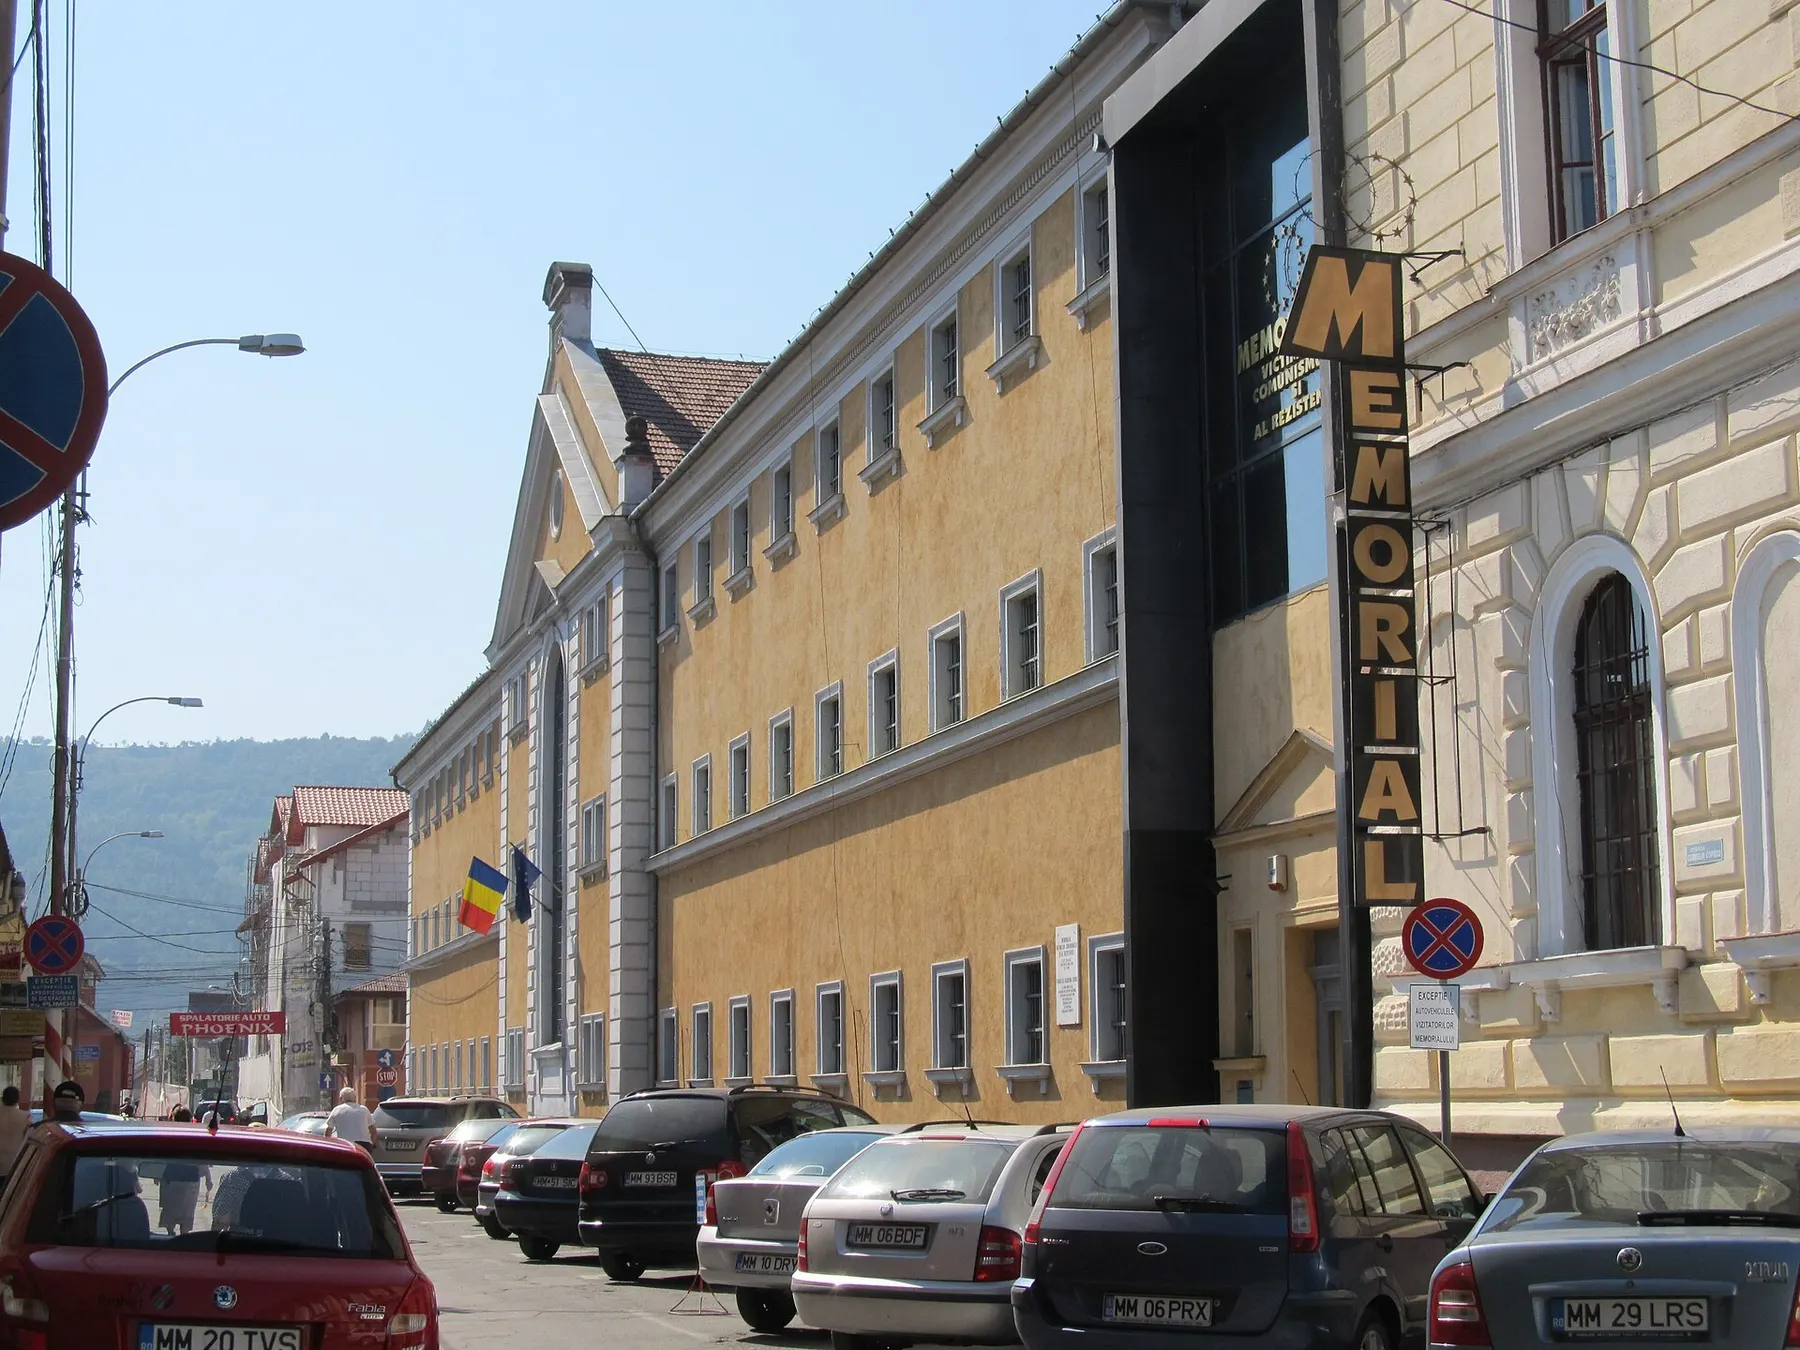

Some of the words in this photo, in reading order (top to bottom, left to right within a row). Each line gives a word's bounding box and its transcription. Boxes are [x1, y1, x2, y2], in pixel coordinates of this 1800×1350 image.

[1237, 317, 1287, 375] MEMO
[1254, 423, 1269, 441] AL
[1292, 256, 1417, 901] MEMORIAL
[179, 1014, 240, 1022] SPALATORIE
[241, 1014, 271, 1022] AUTO
[181, 1022, 275, 1034] PHOENIX
[1415, 1021, 1454, 1029] VIZITATORILOR
[1414, 1034, 1455, 1044] MEMORIALULUI
[379, 1071, 396, 1081] STOP
[631, 1173, 643, 1184] MM
[855, 1226, 873, 1243] MM
[742, 1255, 757, 1270] MM
[761, 1256, 772, 1270] 10
[347, 1302, 386, 1313] Fabia
[1114, 1298, 1138, 1318] MM
[1567, 1303, 1601, 1328] MM
[1611, 1302, 1642, 1328] 29
[1649, 1302, 1704, 1328] LRS
[1553, 1317, 1564, 1328] RO
[156, 1328, 193, 1350] MM
[203, 1329, 235, 1350] 20
[243, 1330, 297, 1350] TVS
